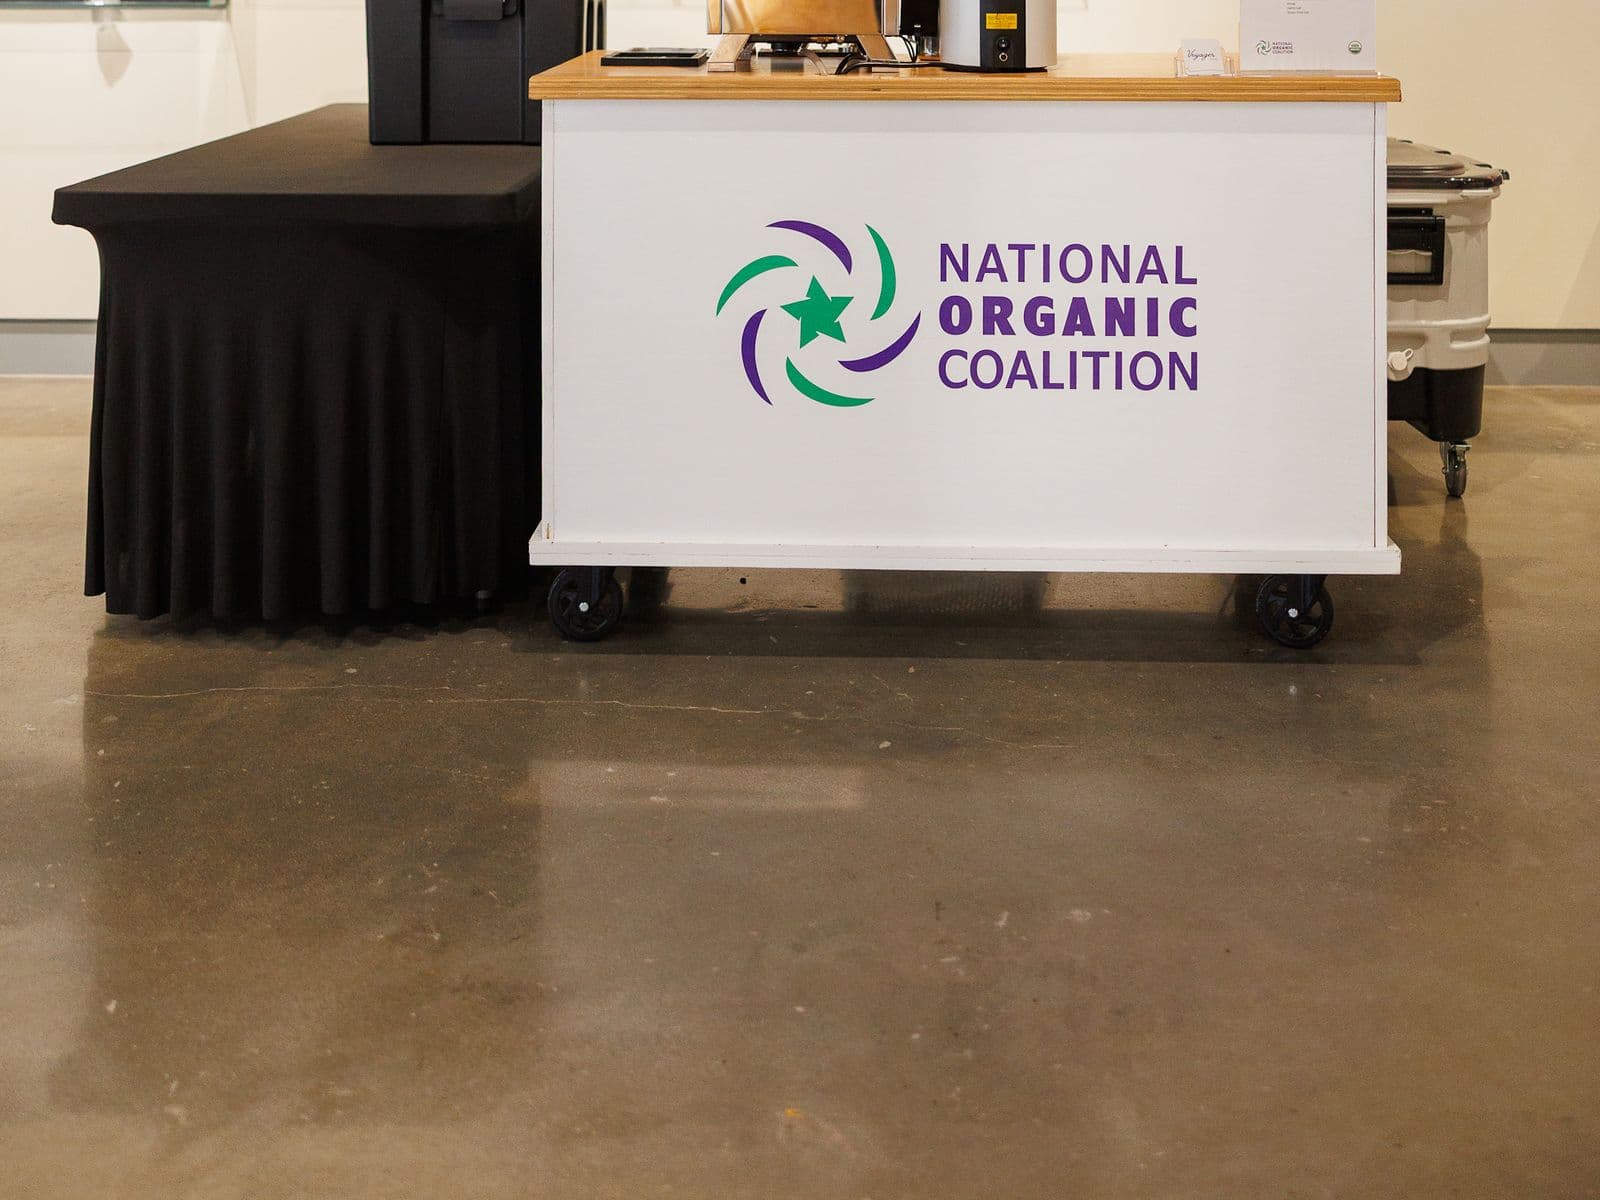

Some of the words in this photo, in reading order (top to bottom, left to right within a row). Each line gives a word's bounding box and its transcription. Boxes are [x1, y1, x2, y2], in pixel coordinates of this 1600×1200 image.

[939, 243, 1198, 285] NATIONAL
[939, 295, 1198, 337] ORGANIC
[938, 349, 1198, 391] COALITION
